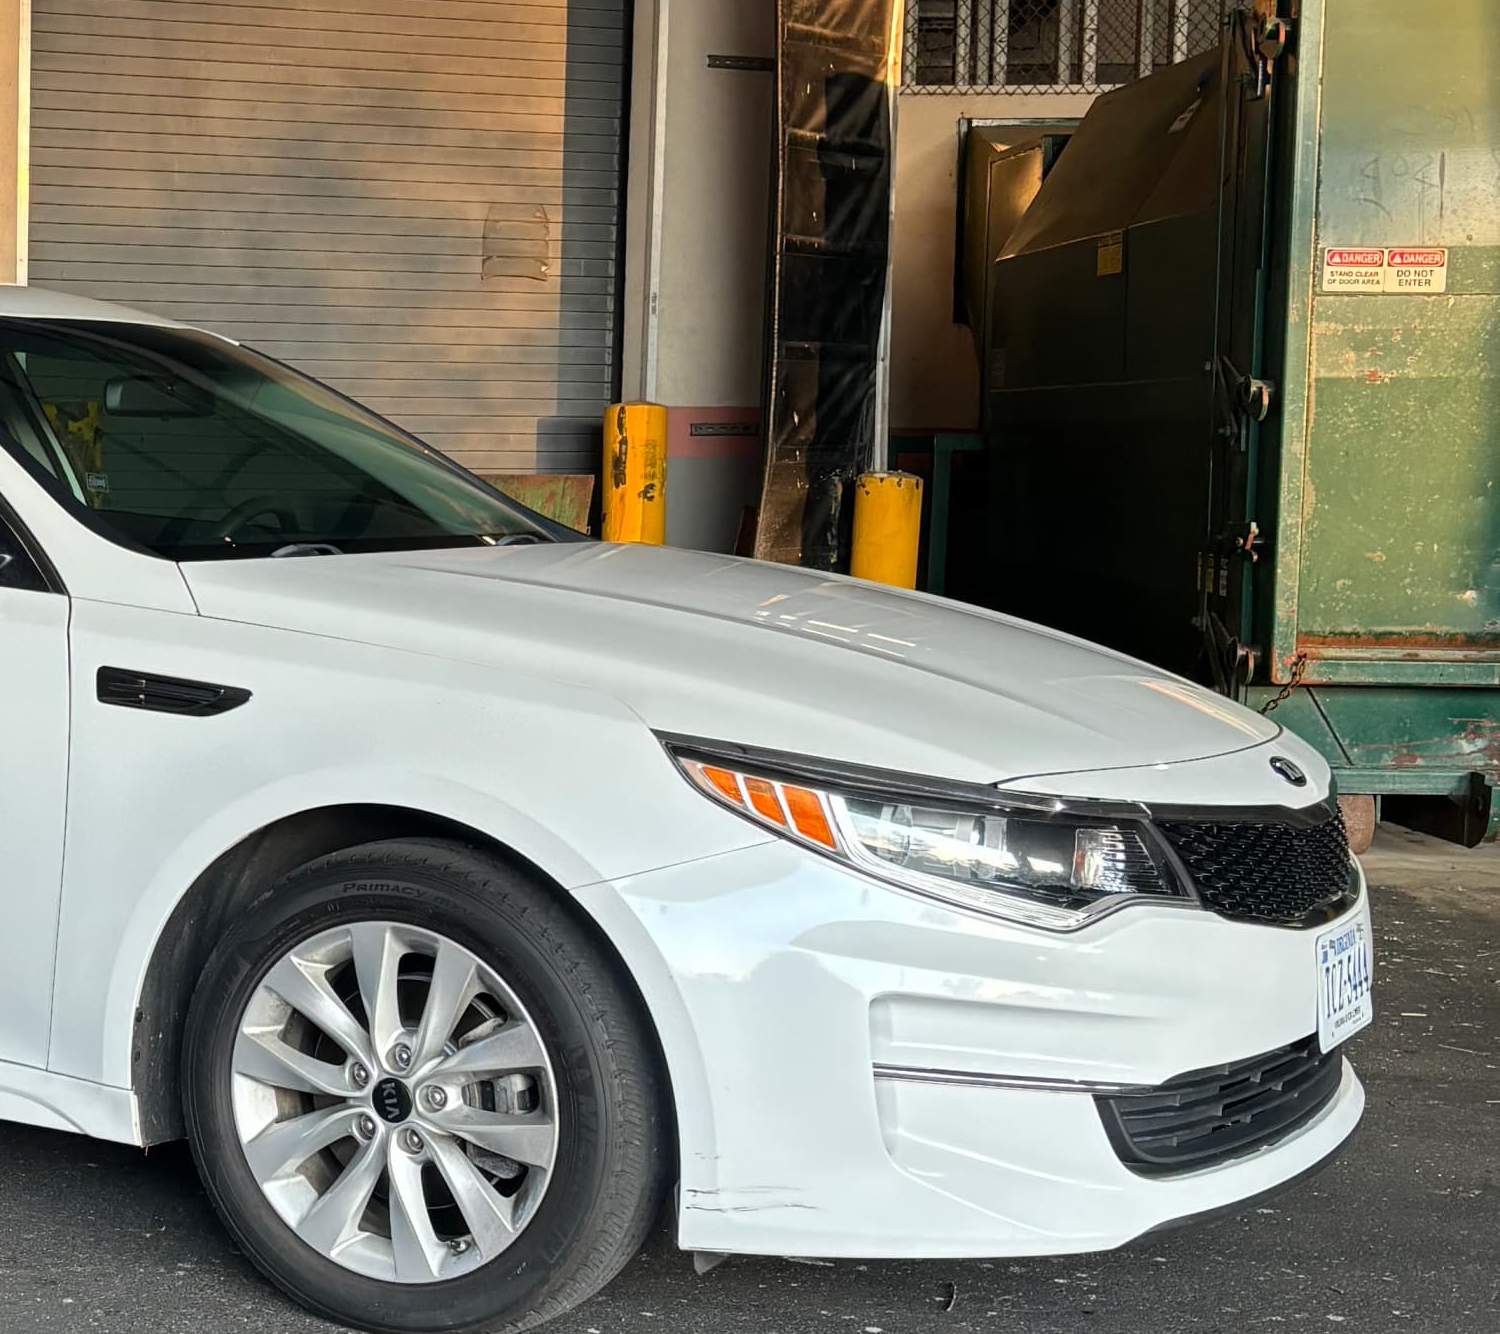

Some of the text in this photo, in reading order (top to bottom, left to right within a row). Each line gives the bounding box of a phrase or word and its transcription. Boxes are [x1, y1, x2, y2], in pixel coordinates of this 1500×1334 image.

[1341, 253, 1380, 264] DANGER
[1403, 253, 1441, 264] DANGER
[1396, 269, 1435, 278] DO NOT
[1398, 278, 1432, 287] ENTER
[382, 1082, 400, 1119] KIA
